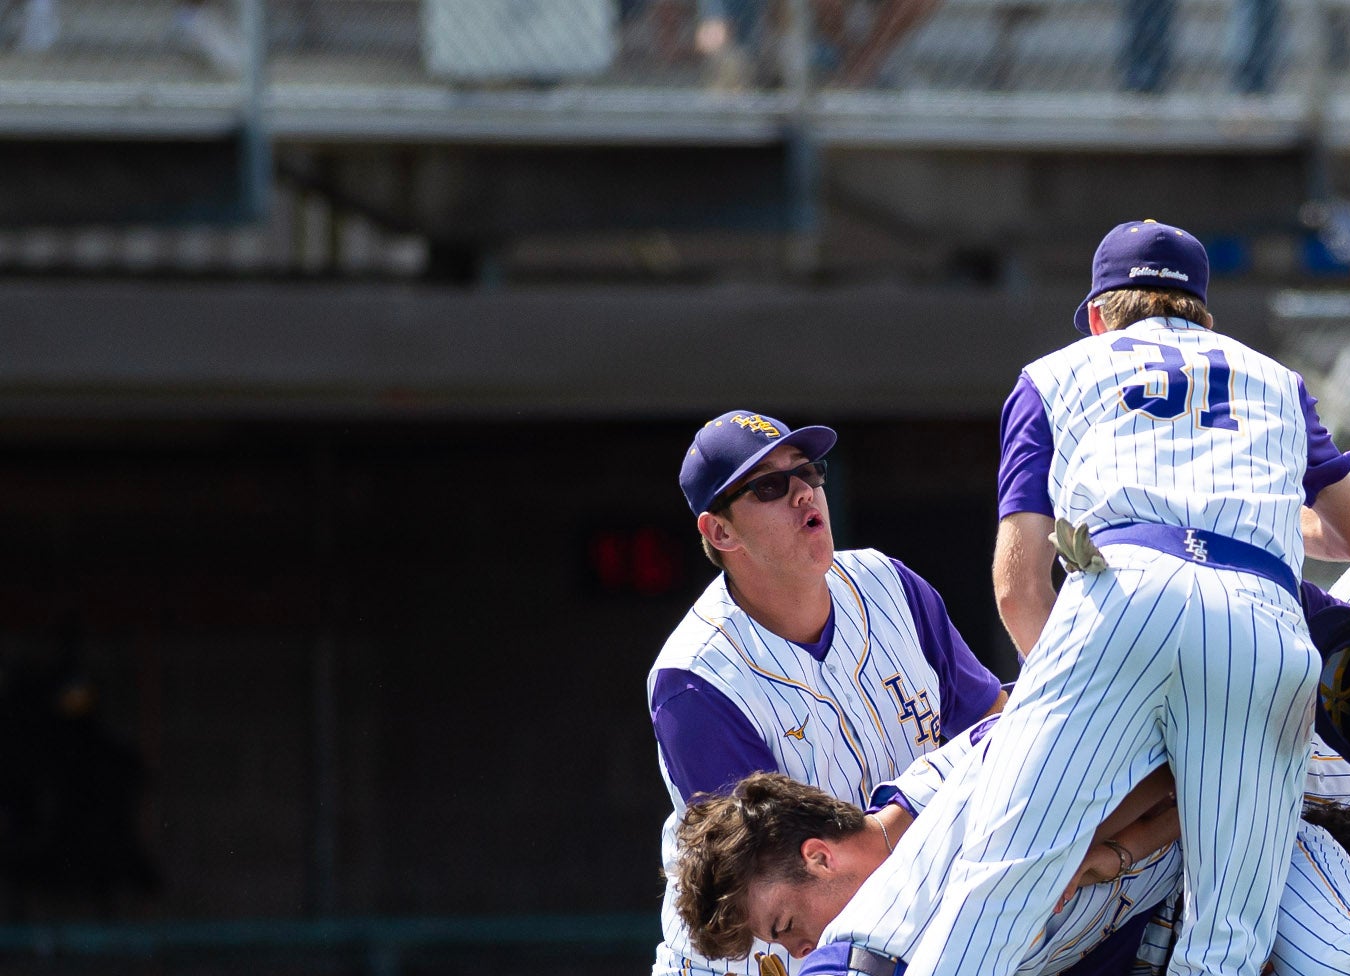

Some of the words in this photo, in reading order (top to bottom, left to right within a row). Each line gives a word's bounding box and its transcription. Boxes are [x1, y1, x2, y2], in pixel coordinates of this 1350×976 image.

[1129, 266, 1159, 278] Yellow
[1110, 336, 1245, 437] 31
[1183, 529, 1208, 563] LHS
